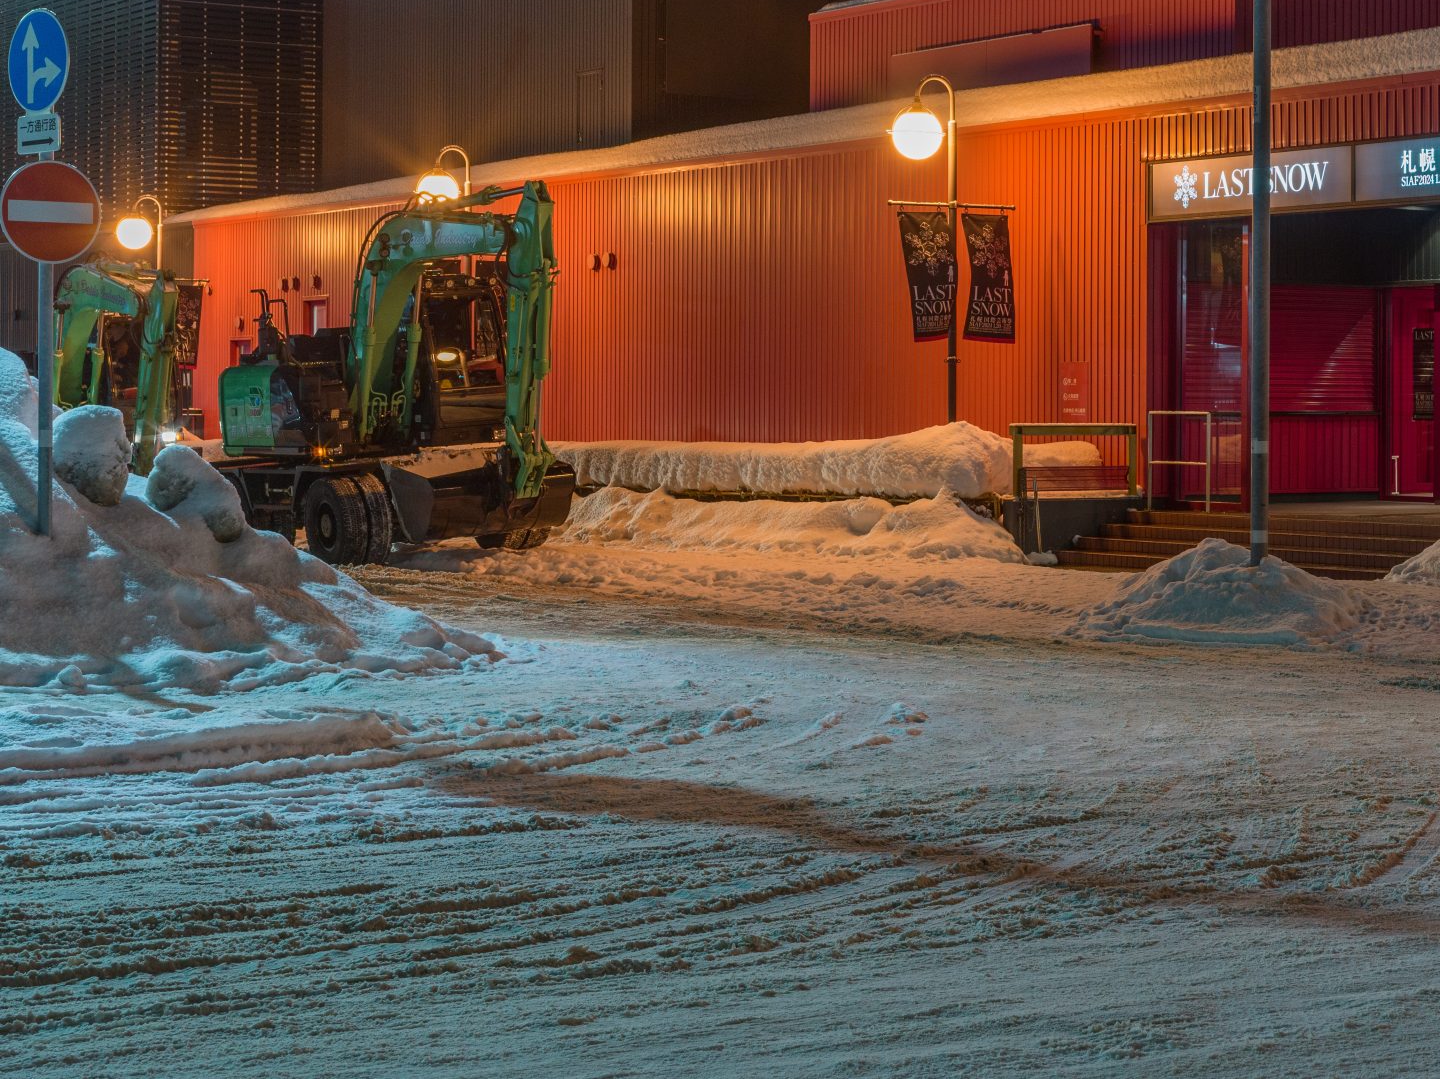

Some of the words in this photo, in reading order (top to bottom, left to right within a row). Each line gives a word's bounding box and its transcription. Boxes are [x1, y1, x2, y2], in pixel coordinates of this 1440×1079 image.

[20, 118, 57, 133] 一方通行路
[912, 284, 956, 301] LAST
[973, 286, 1012, 303] LAST
[915, 300, 953, 315] SNOW
[971, 302, 1012, 317] SNOW
[1415, 330, 1434, 340] LAST
